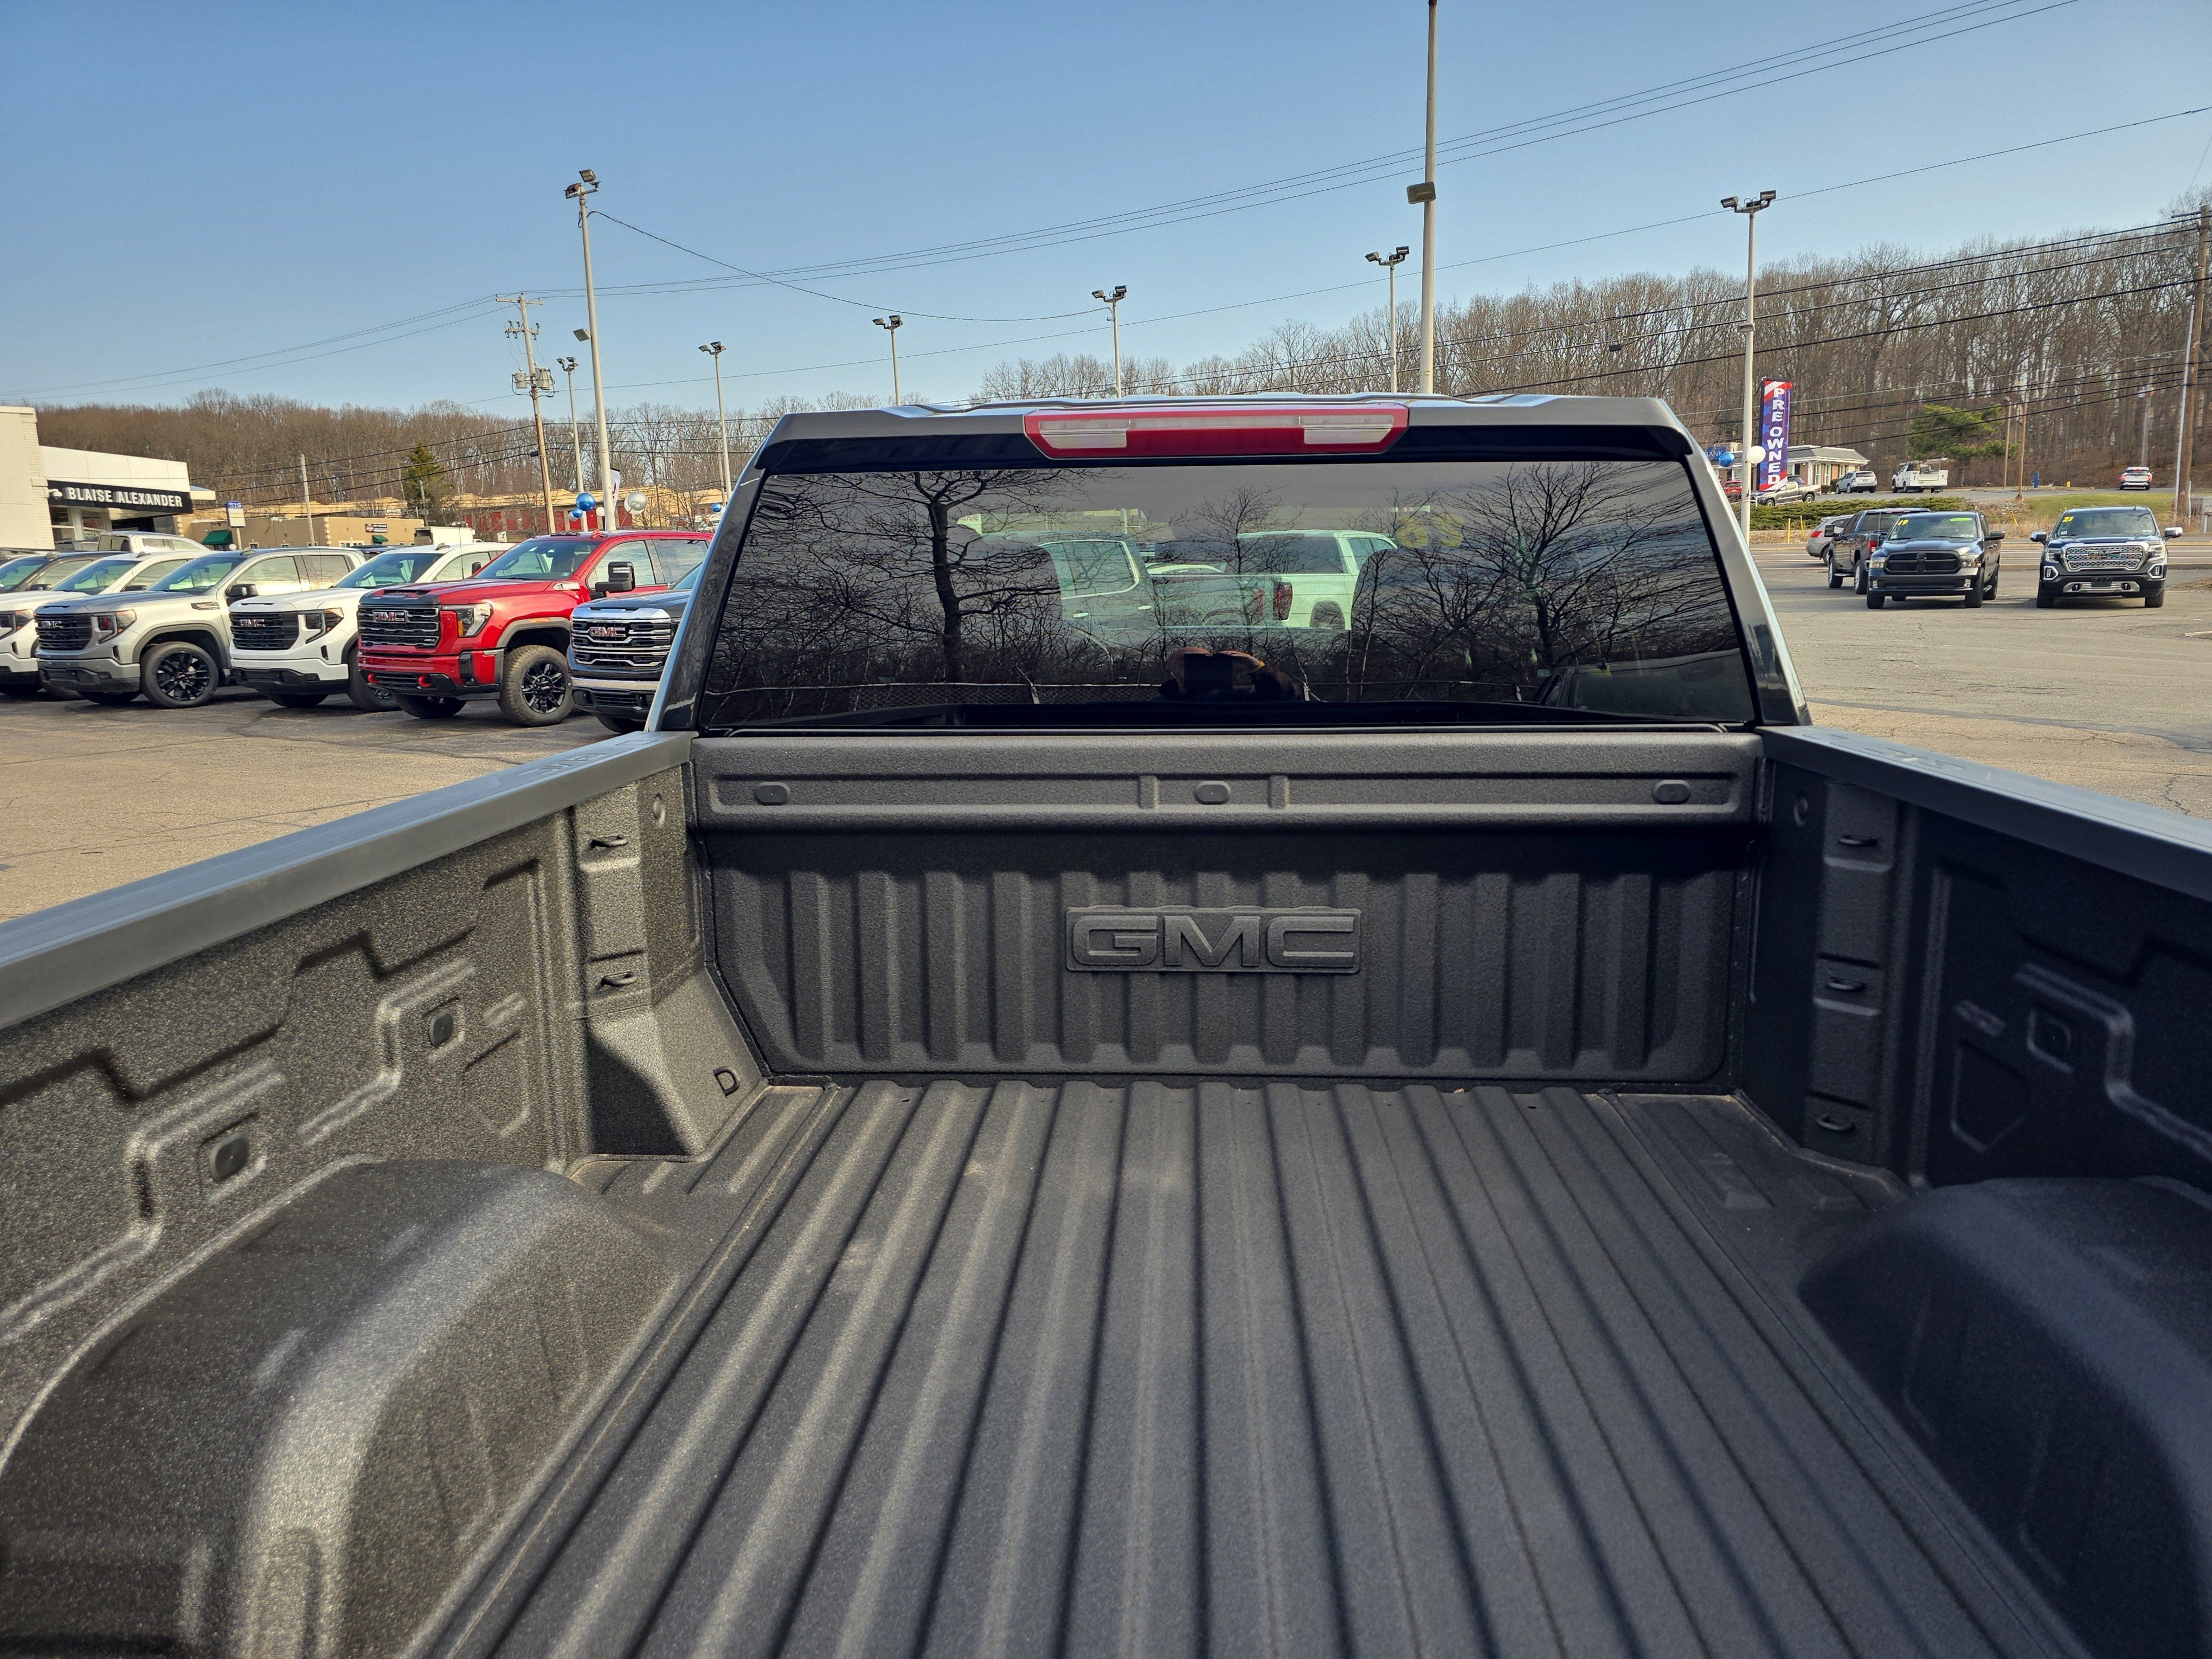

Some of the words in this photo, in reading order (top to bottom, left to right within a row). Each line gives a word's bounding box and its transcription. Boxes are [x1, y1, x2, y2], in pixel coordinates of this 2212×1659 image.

[1772, 387, 1785, 422] PRE
[1767, 426, 1785, 485] OWNED
[66, 487, 113, 503] BLAISE
[115, 491, 183, 507] ALEXANDER
[374, 612, 406, 622] GMC
[589, 627, 627, 638] GMC
[1072, 915, 1354, 968] GMC
